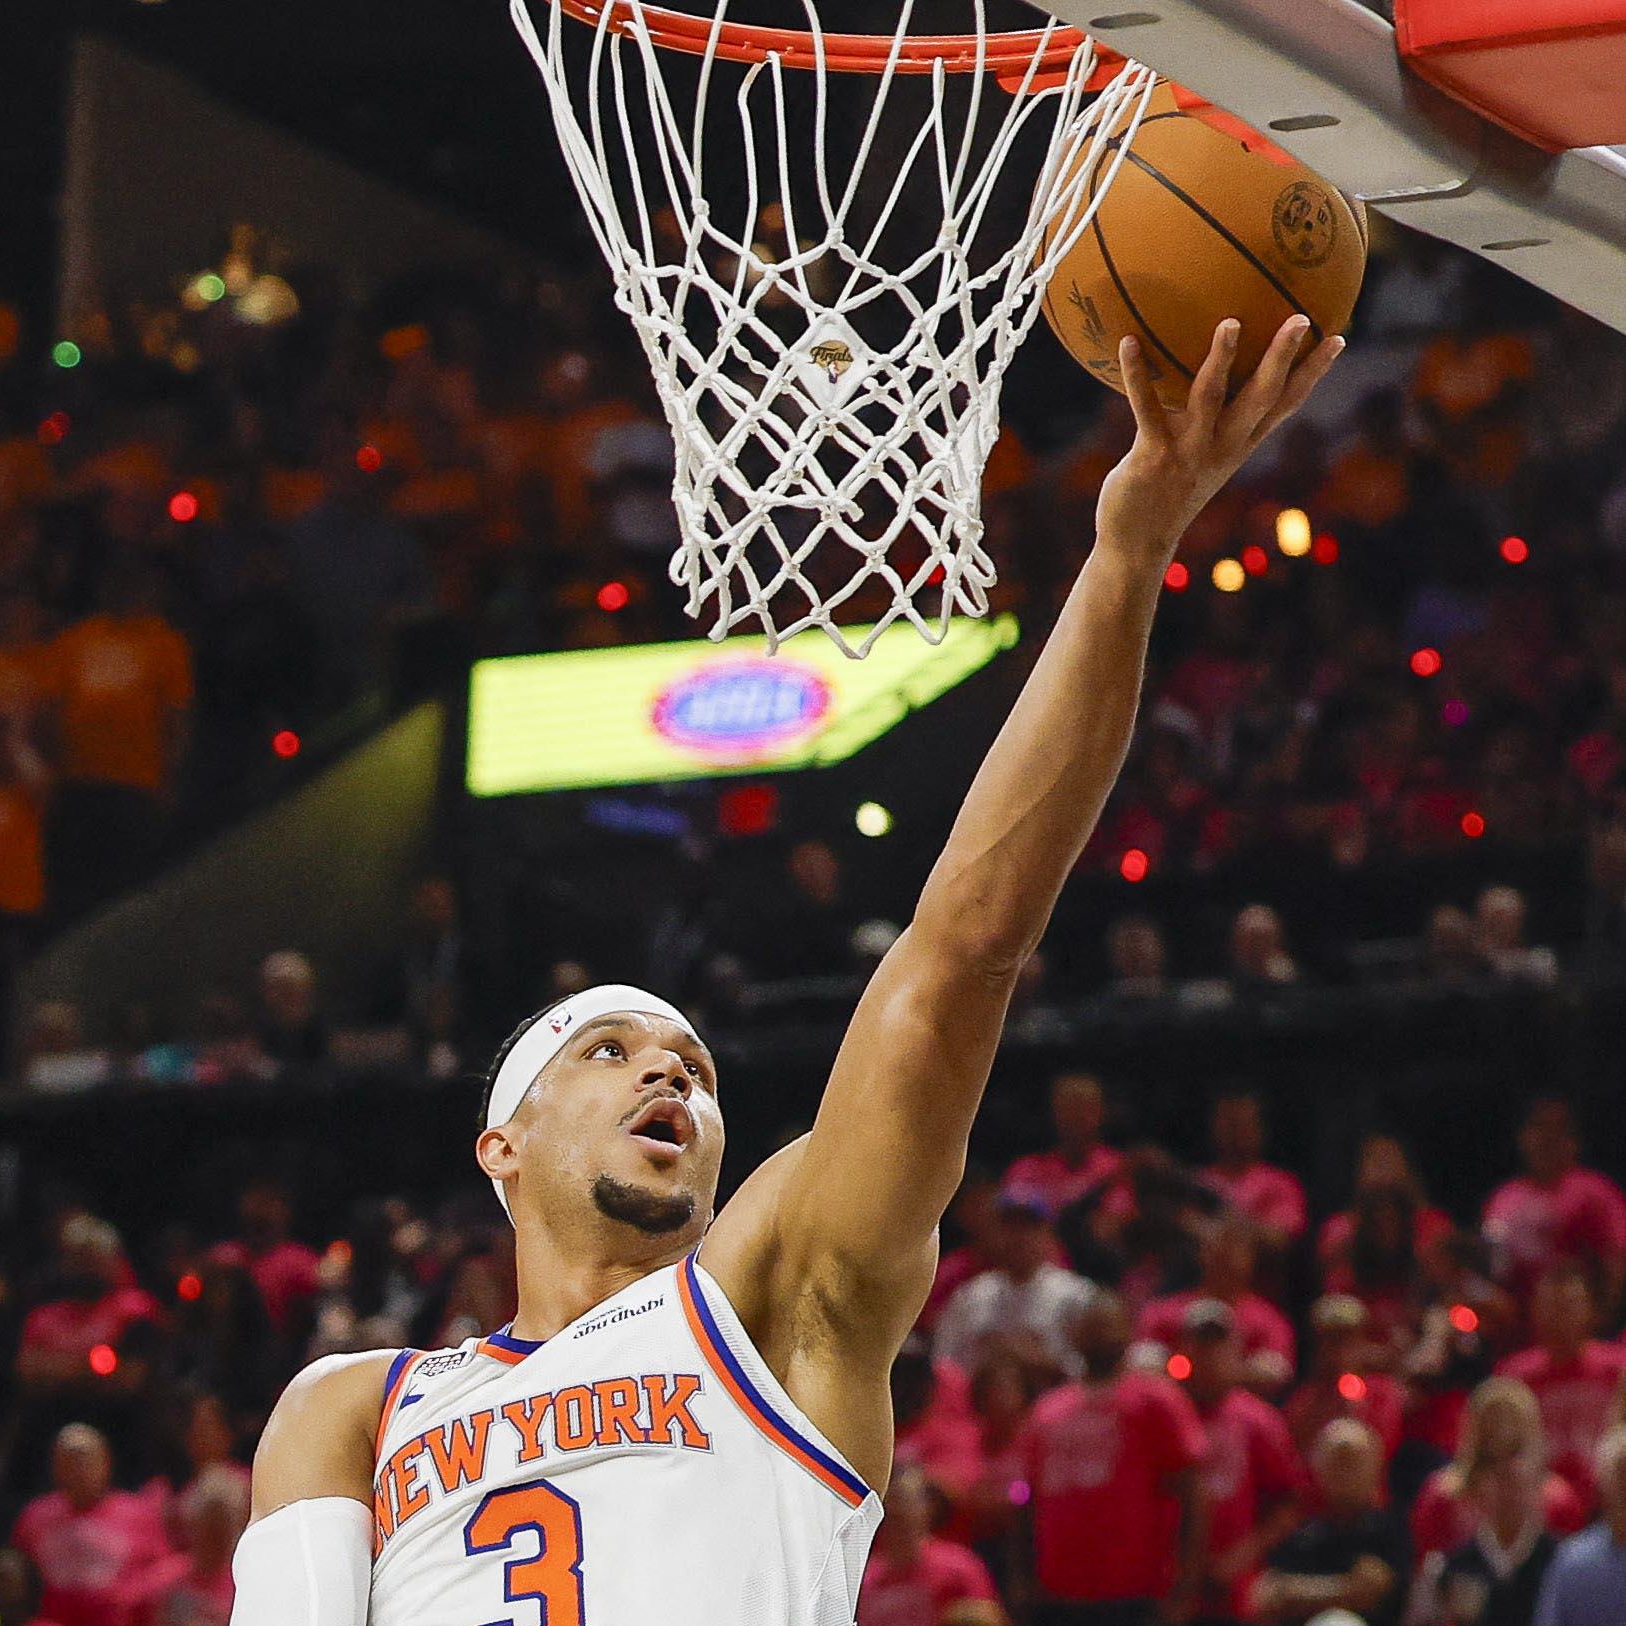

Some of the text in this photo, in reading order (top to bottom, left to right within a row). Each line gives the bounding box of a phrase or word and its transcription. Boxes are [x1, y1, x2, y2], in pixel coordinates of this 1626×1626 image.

[808, 346, 854, 364] Finals
[573, 1294, 665, 1340] abu dhabi
[374, 1373, 712, 1560] NEW YORK
